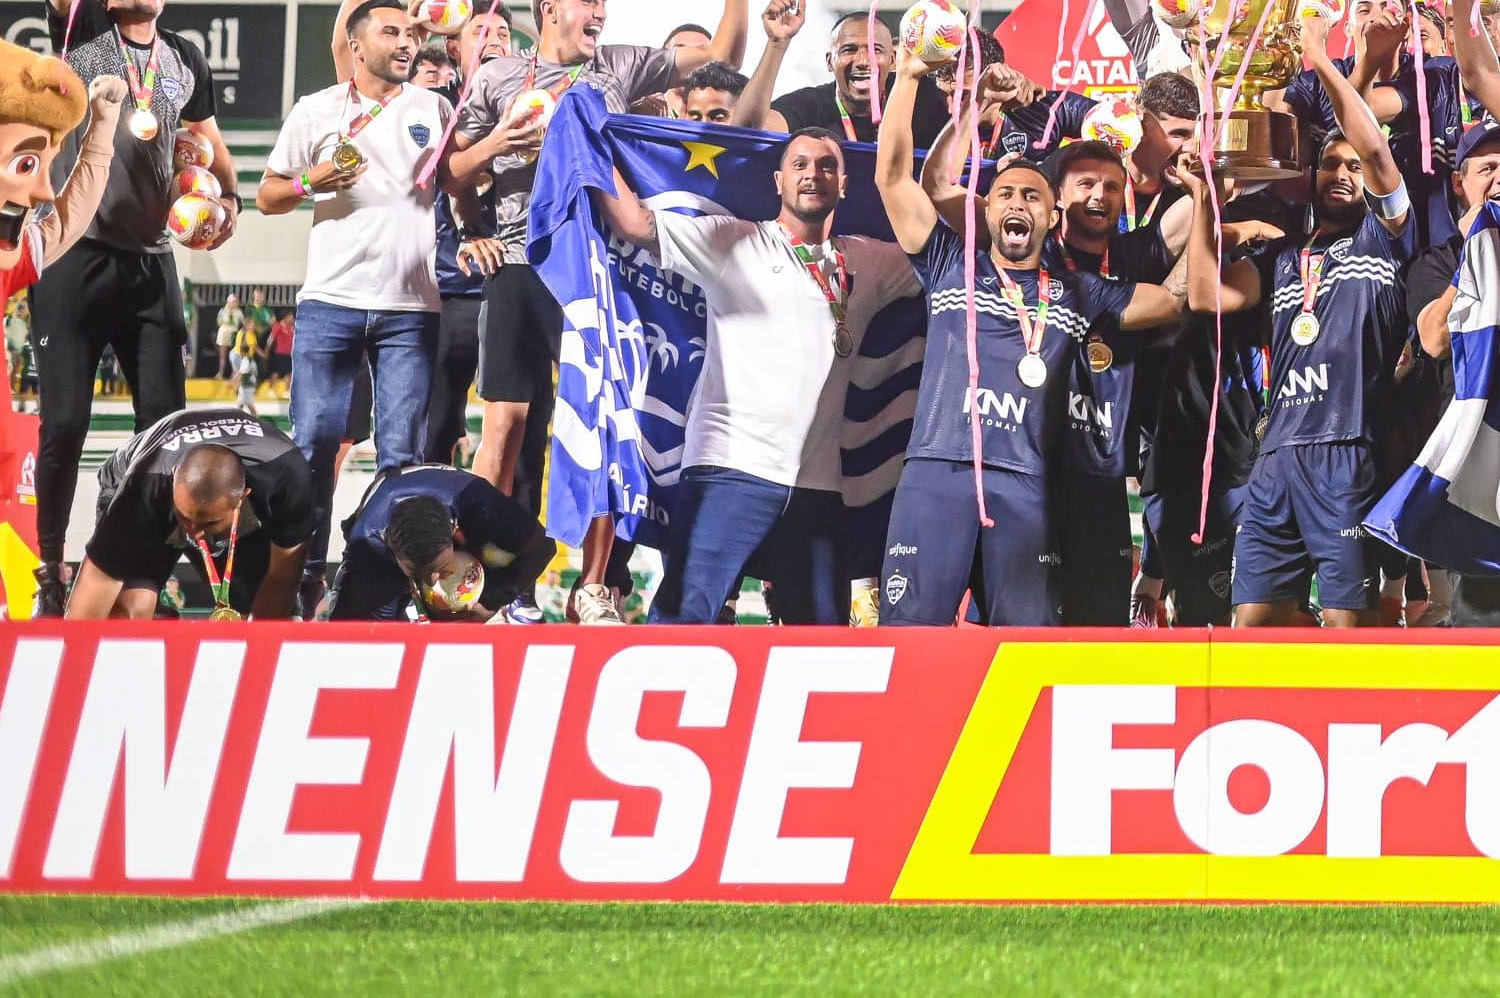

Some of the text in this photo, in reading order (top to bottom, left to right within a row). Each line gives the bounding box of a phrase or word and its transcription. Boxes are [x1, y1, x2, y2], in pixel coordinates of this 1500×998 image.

[606, 252, 689, 312] FUTEBOL
[1282, 394, 1324, 409] IDIOMAS
[966, 417, 1018, 433] IIOMAS
[161, 423, 264, 452] BARRA
